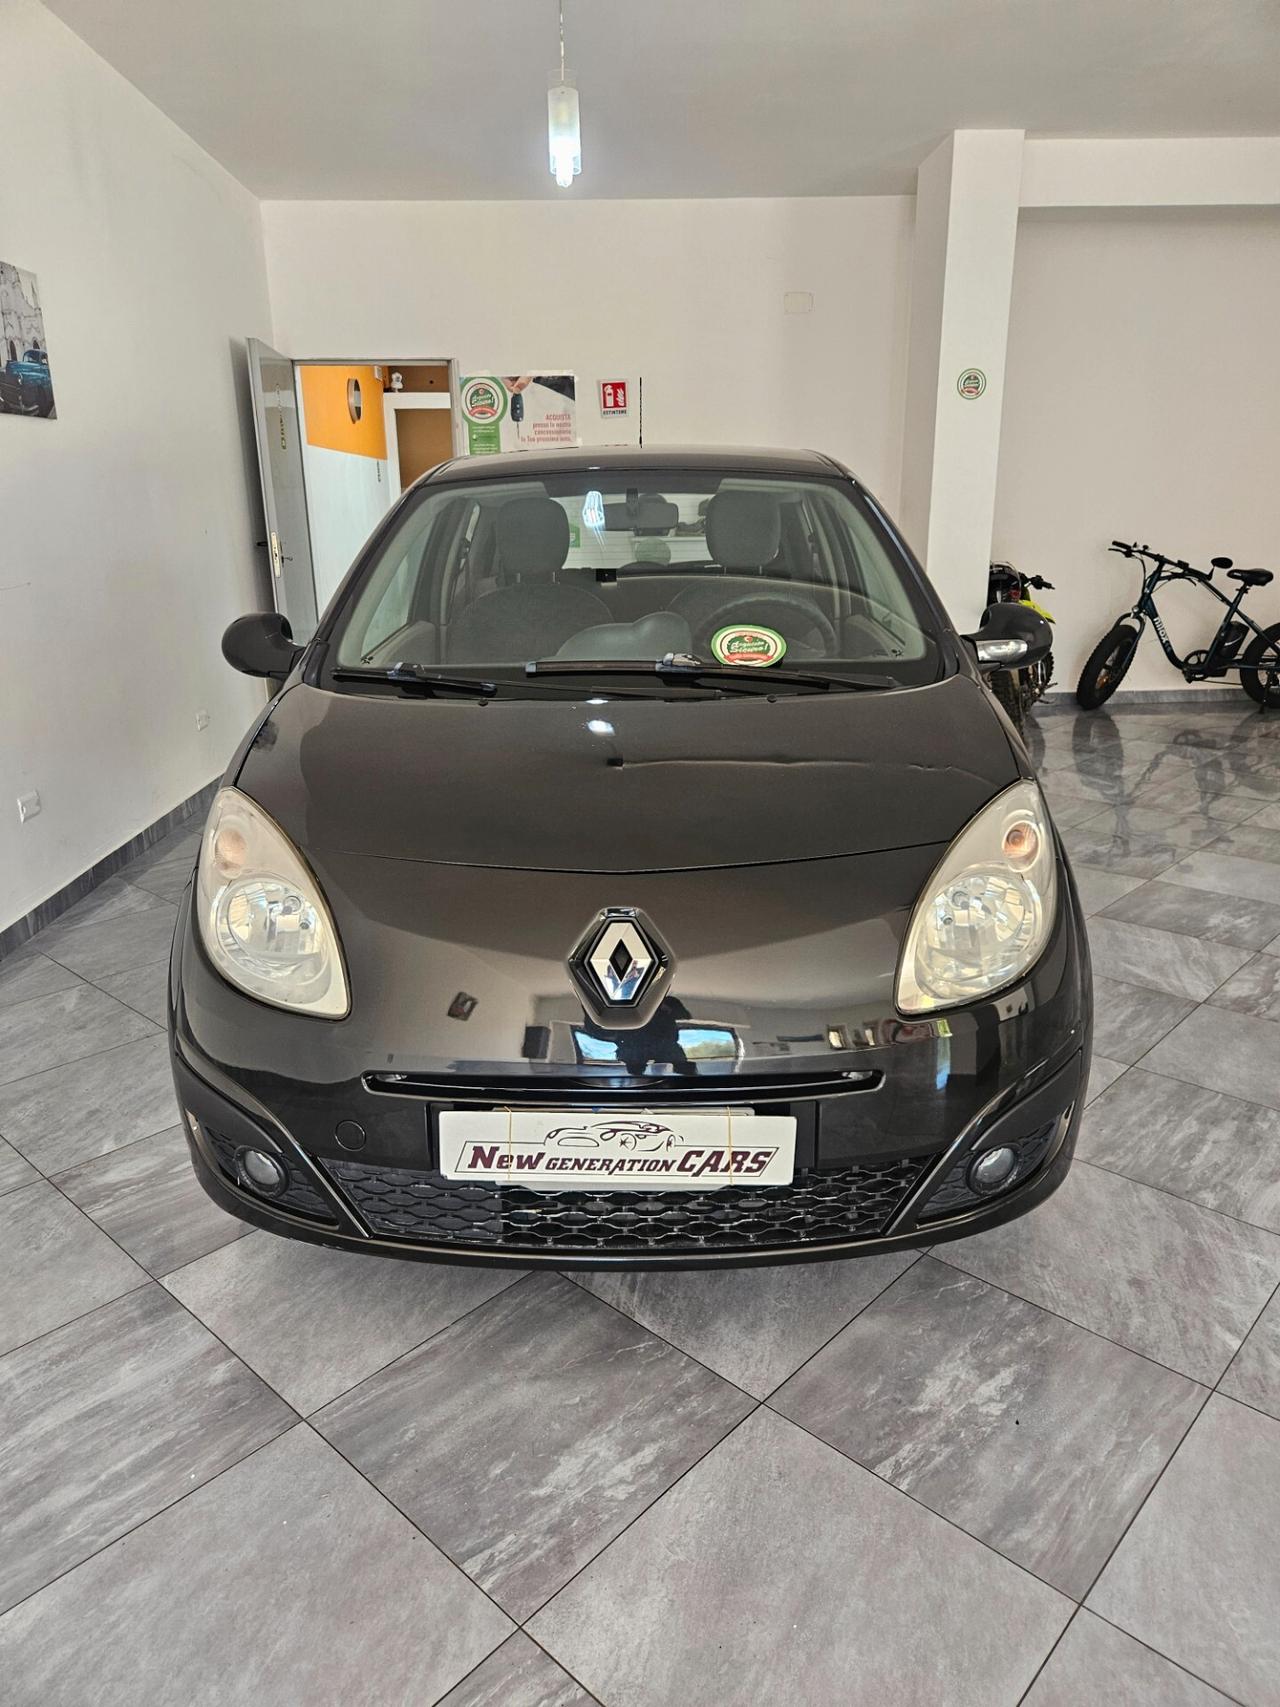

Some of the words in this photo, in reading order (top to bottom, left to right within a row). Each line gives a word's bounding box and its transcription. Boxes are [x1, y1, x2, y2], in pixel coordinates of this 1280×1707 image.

[545, 413, 571, 421] ACQUISTA
[1153, 617, 1168, 643] nilox
[545, 1156, 679, 1175] GENERATION
[677, 1149, 772, 1177] CARS
